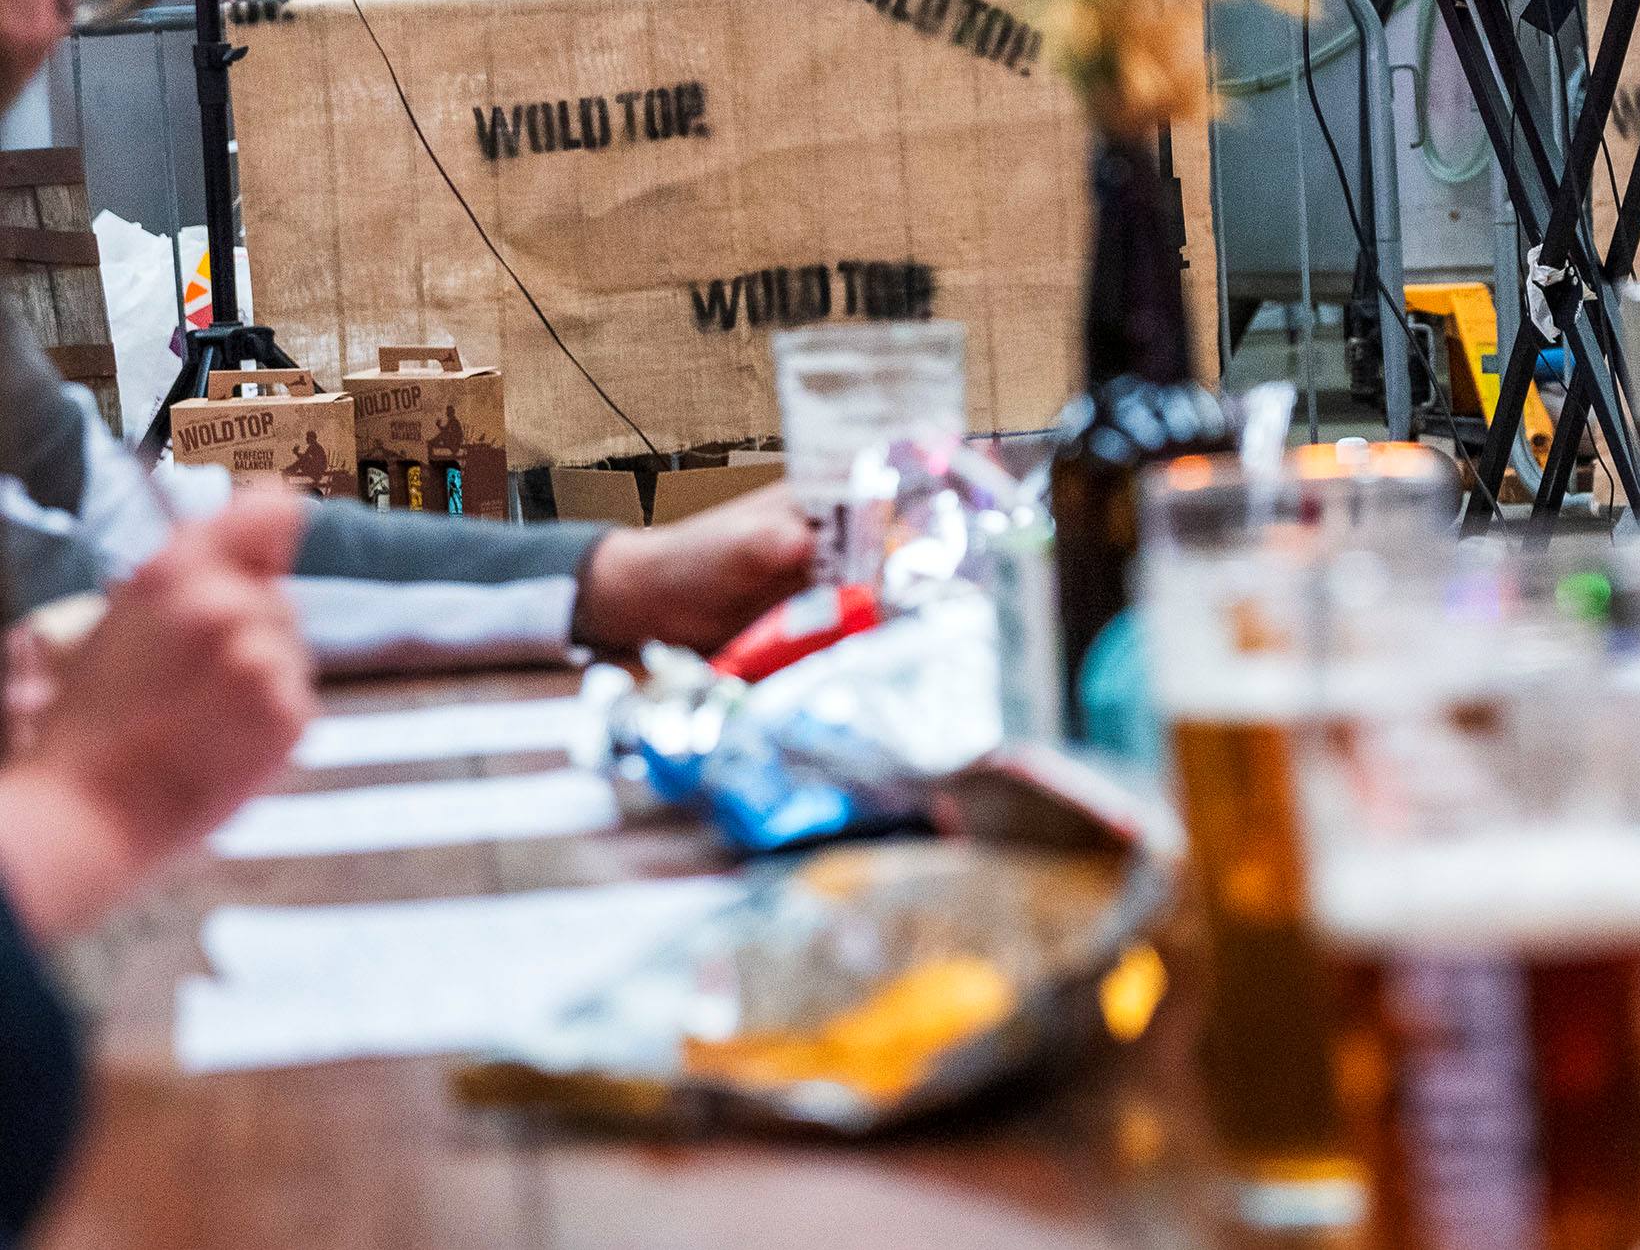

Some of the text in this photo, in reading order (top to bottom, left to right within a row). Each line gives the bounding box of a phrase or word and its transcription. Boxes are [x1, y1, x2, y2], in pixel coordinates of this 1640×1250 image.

[472, 94, 612, 162] WOLD
[688, 263, 832, 334] WOLD
[392, 385, 422, 410] TOP
[178, 411, 275, 452] WOLD TOP
